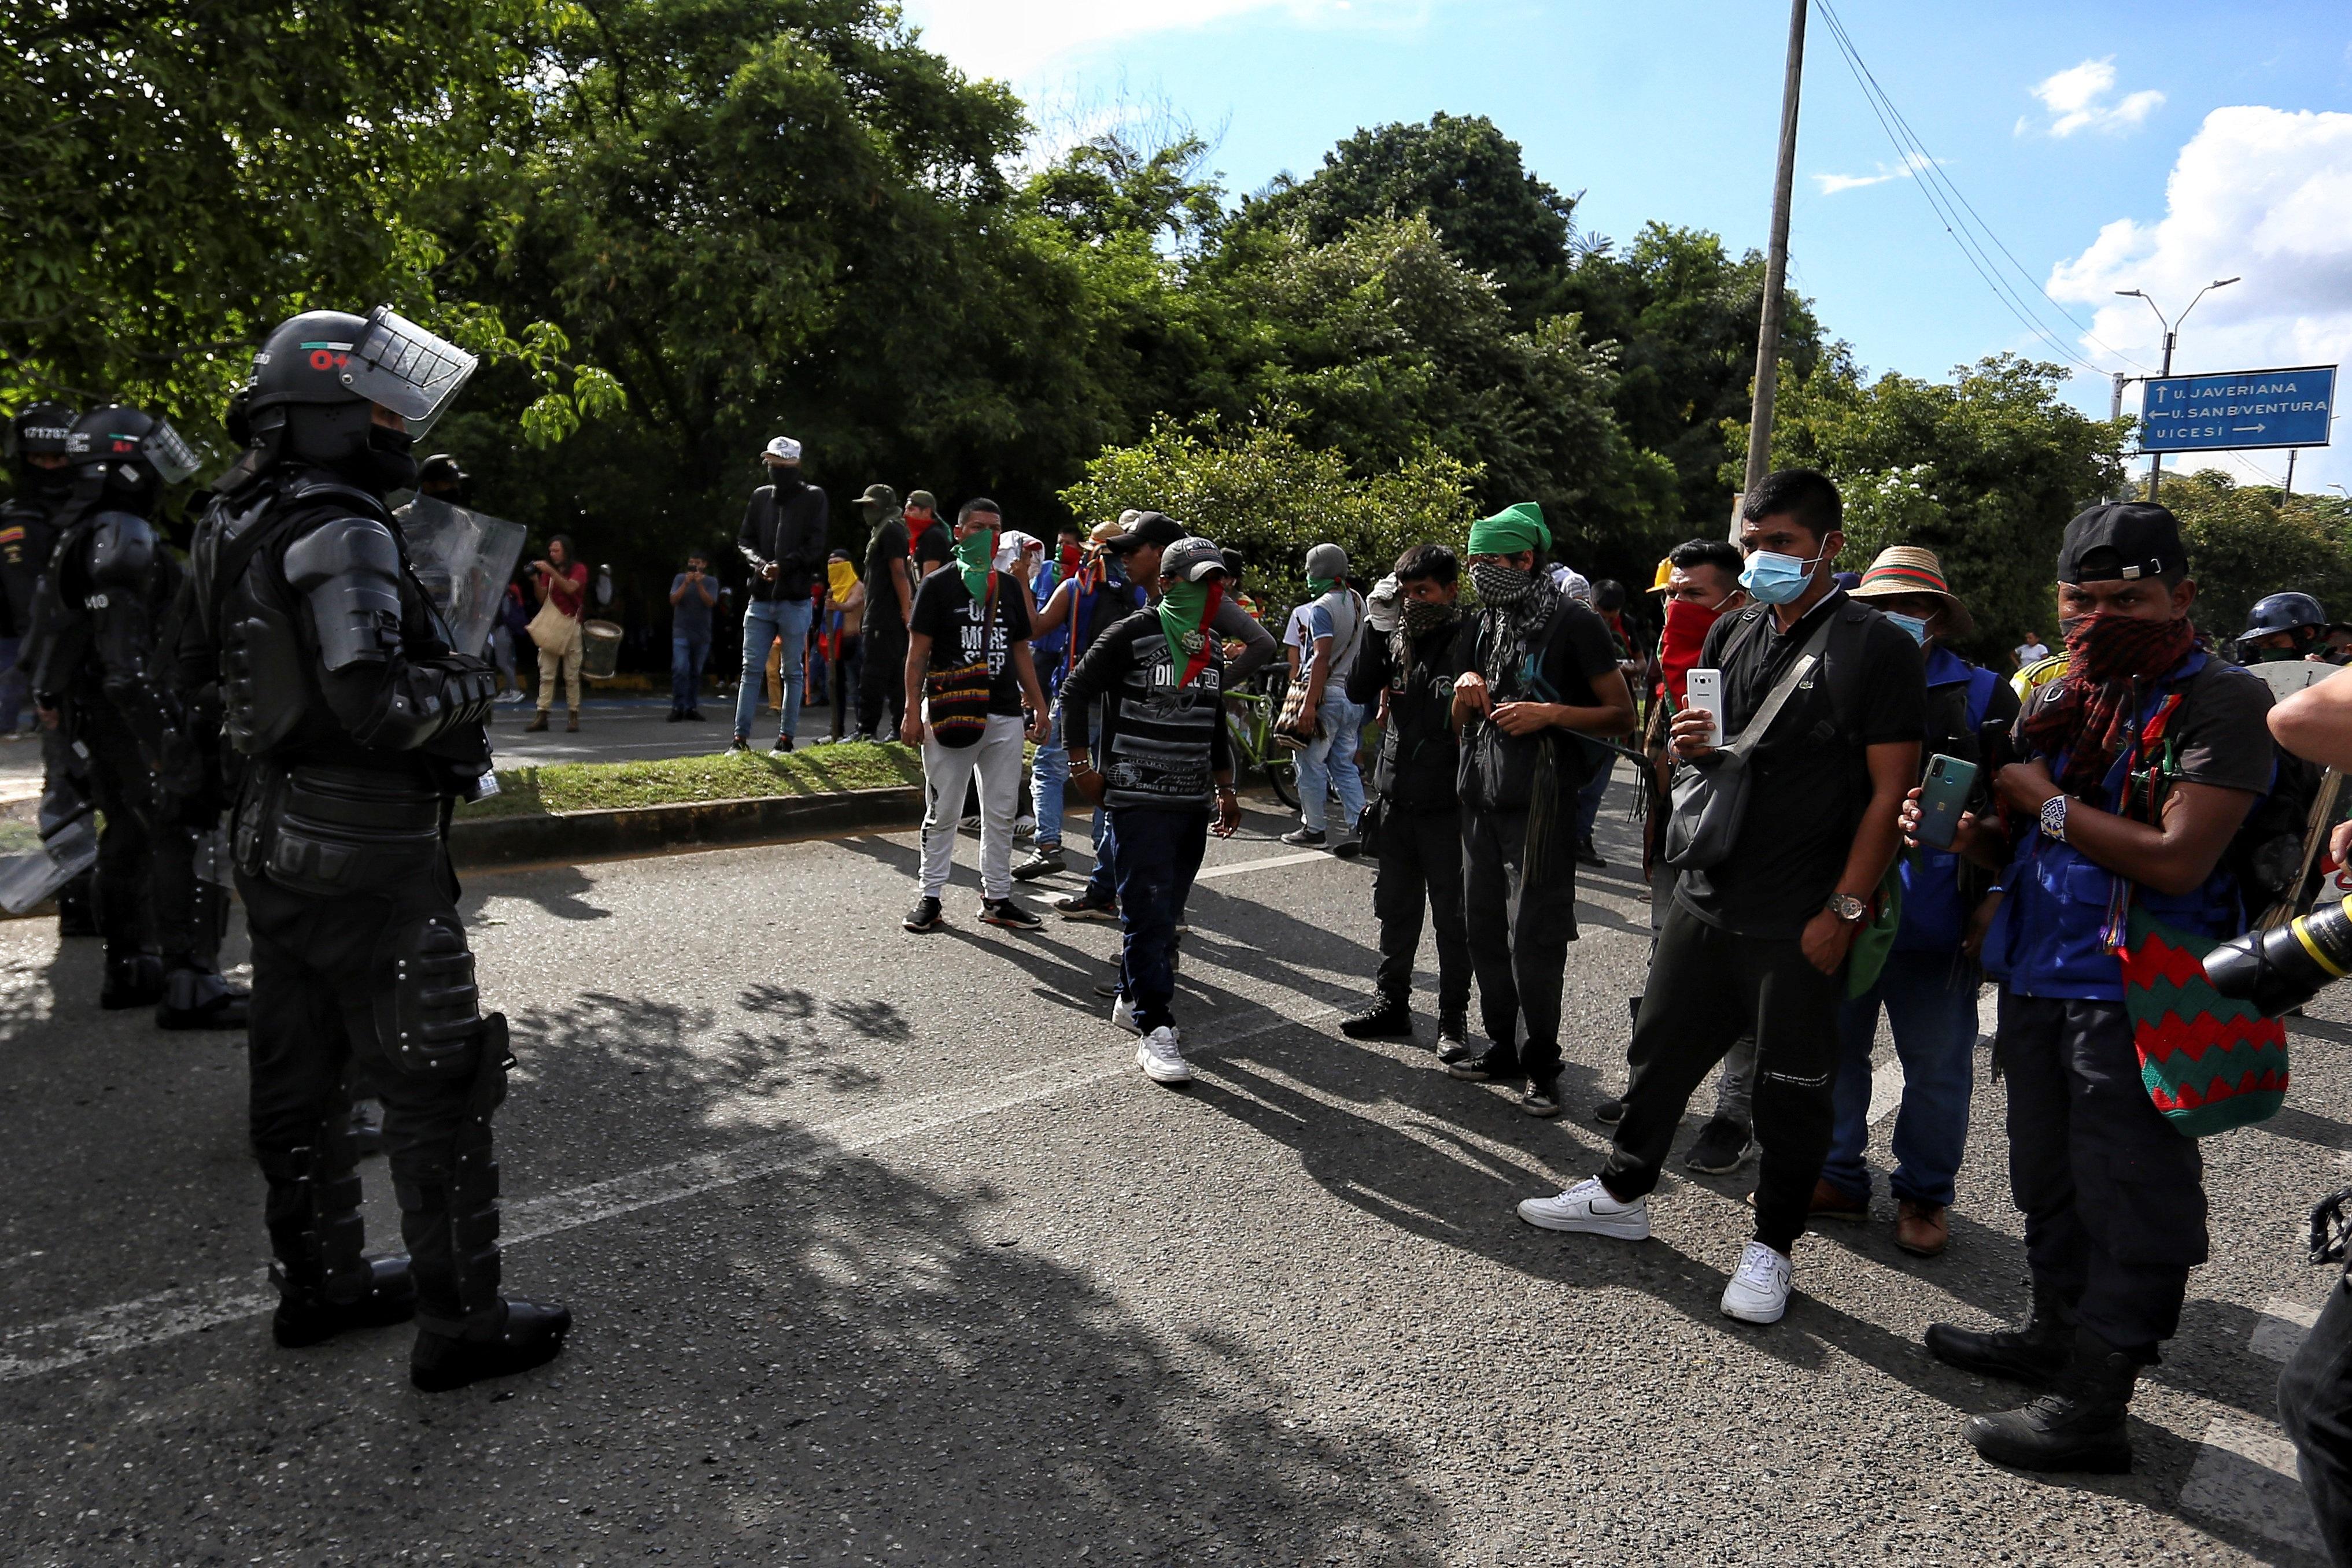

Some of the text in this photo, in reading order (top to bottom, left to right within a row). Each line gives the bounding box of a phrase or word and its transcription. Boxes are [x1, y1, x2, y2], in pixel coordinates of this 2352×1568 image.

[2174, 383, 2297, 399] U. JAVERIANA
[2172, 409, 2184, 419] U.
[1135, 782, 1167, 792] SMILE
